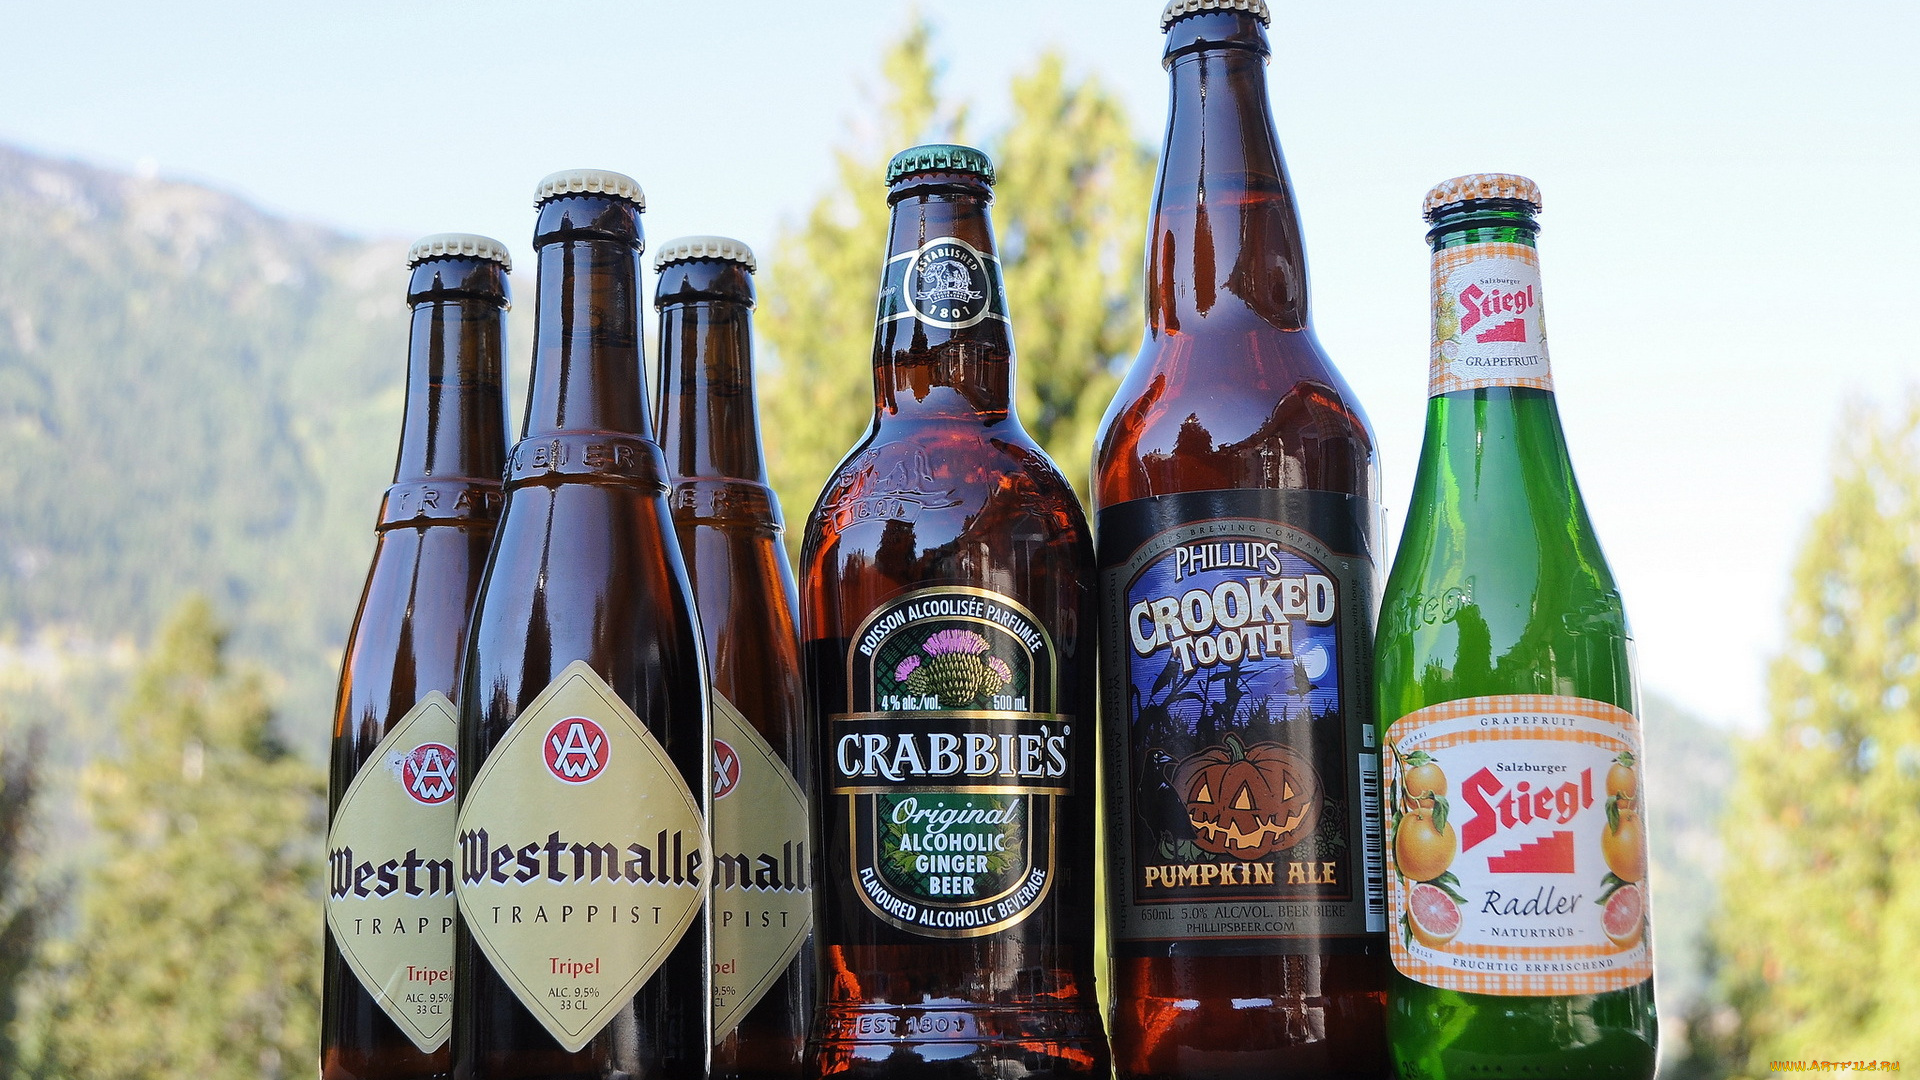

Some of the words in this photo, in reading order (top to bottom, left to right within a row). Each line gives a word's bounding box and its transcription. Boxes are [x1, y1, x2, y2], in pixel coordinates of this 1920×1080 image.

[916, 248, 978, 273] ESTABLISHED
[1480, 278, 1520, 286] Salzburger
[928, 304, 971, 319] 1801
[1459, 283, 1534, 335] Stiegl
[1466, 355, 1539, 366] GRAPEFRUIT
[1131, 533, 1182, 569] PHILLIPS
[1190, 524, 1256, 536] BREWING
[1265, 526, 1329, 560] COMPANY
[1174, 542, 1282, 581] PHILLIPS
[1129, 573, 1337, 659] CROOKED
[859, 609, 906, 656] BOISSON
[908, 597, 984, 622] ALCOOLISÉE
[985, 604, 1043, 653] PARFUMÉE
[1171, 624, 1294, 675] TOOTH
[902, 694, 941, 711] alc./vol.
[993, 695, 1012, 710] 500
[1480, 717, 1576, 727] GRAPEFRUIT
[1496, 762, 1568, 774] Salzburger
[892, 796, 1019, 833] Original
[1462, 767, 1594, 853] Stiegl
[899, 833, 1006, 851] ALCOHOLIC
[458, 828, 702, 888] Westmalle
[915, 854, 989, 873] GINGER
[1145, 862, 1274, 888] PUMPKIN
[1288, 861, 1338, 885] ALE
[929, 875, 976, 895] BEER
[859, 866, 917, 921] FLAVOURED
[919, 905, 997, 928] ALCOHOLIC
[997, 867, 1046, 919] BEVERAGE
[1480, 885, 1583, 917] Radler
[492, 905, 662, 925] TRAPPIST
[722, 910, 789, 928] PIST
[1181, 908, 1208, 919] 5.0%
[355, 917, 453, 935] TRAPP
[1187, 921, 1295, 933] PHILLIPSBEER.COM
[1491, 926, 1575, 938] NATURTRÜB
[549, 957, 600, 979] Tripel
[714, 959, 736, 979] pel
[1452, 957, 1518, 972] FRUCHTIG
[1525, 958, 1614, 973] ERFRISCHEND
[405, 993, 427, 1003] ALC.
[548, 987, 571, 998] ALC.
[416, 1005, 428, 1015] 33
[430, 1005, 442, 1015] CL
[560, 1000, 572, 1010] 33
[574, 1000, 588, 1010] CL
[859, 1015, 900, 1034] EST
